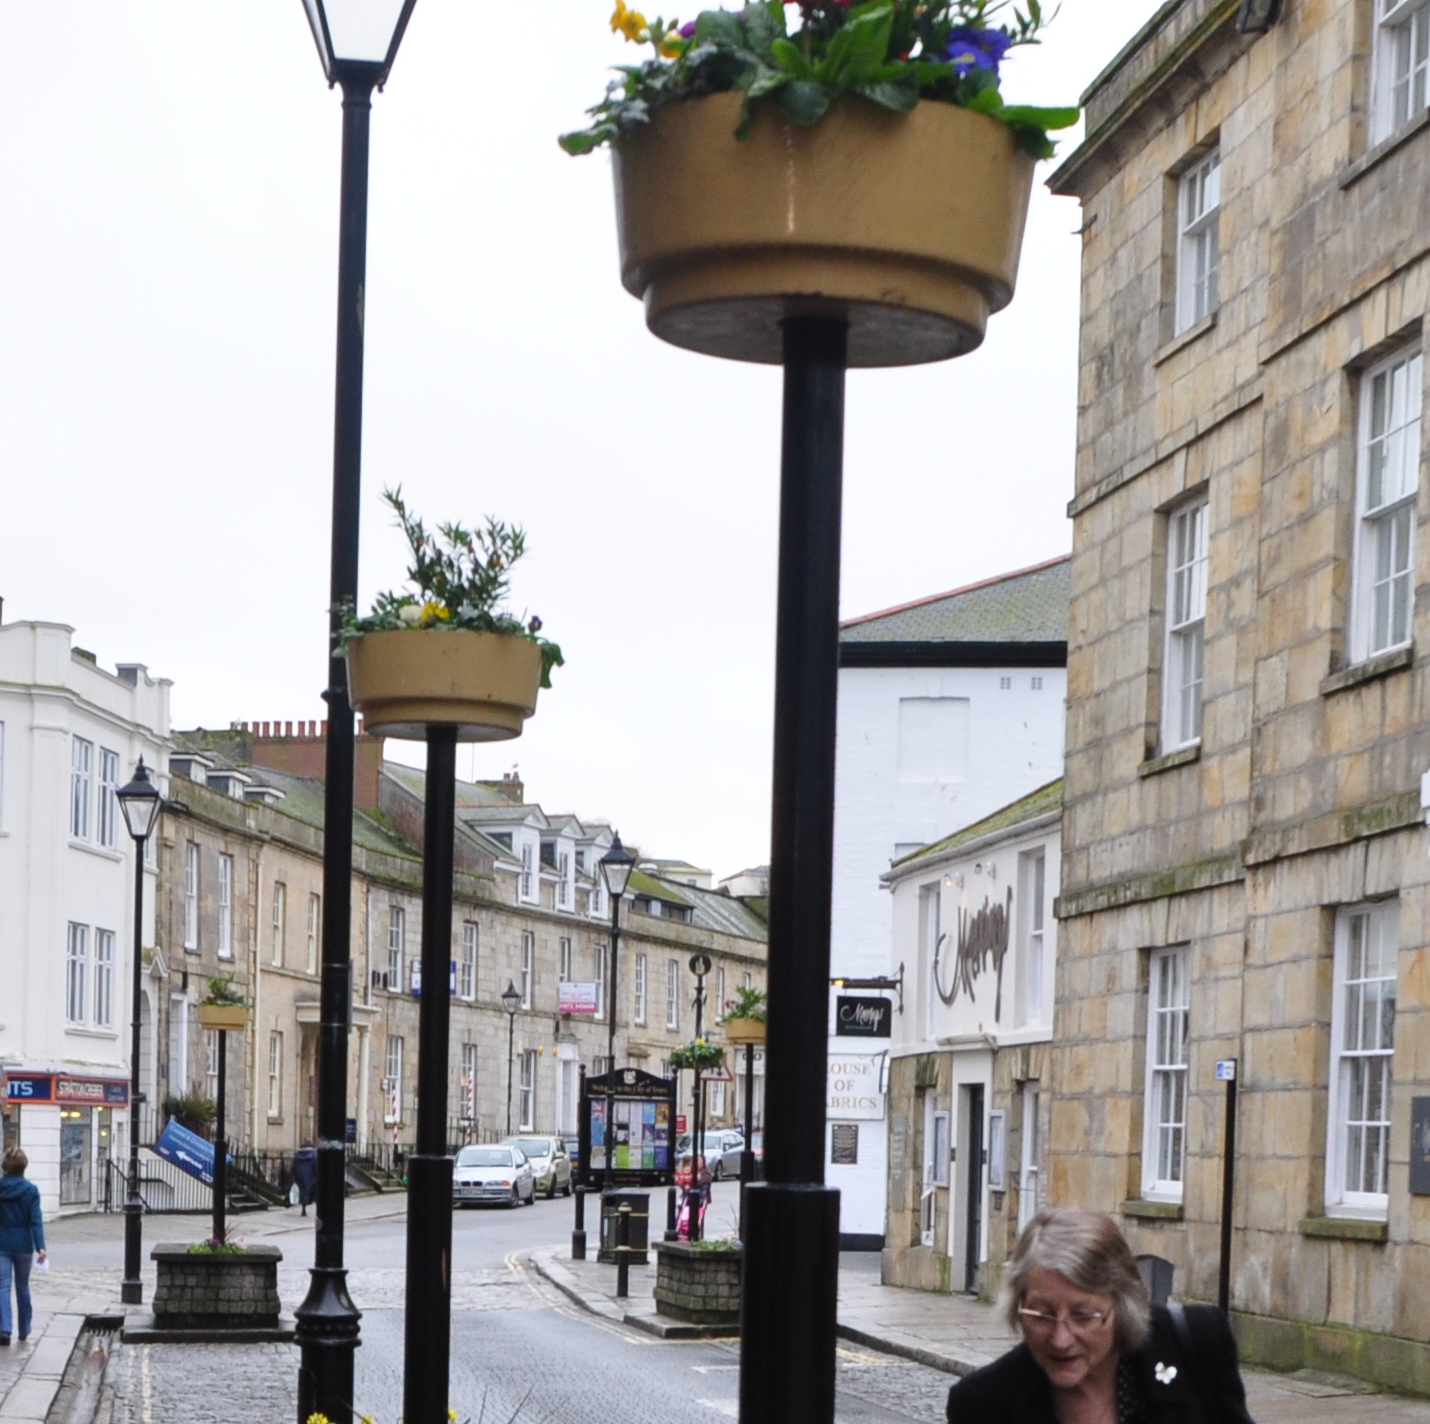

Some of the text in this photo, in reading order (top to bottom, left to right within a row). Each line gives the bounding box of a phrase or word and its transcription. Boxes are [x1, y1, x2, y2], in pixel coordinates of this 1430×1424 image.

[828, 1062, 872, 1076] OUSE
[834, 1080, 856, 1092] OF
[827, 1096, 878, 1109] BRICS
